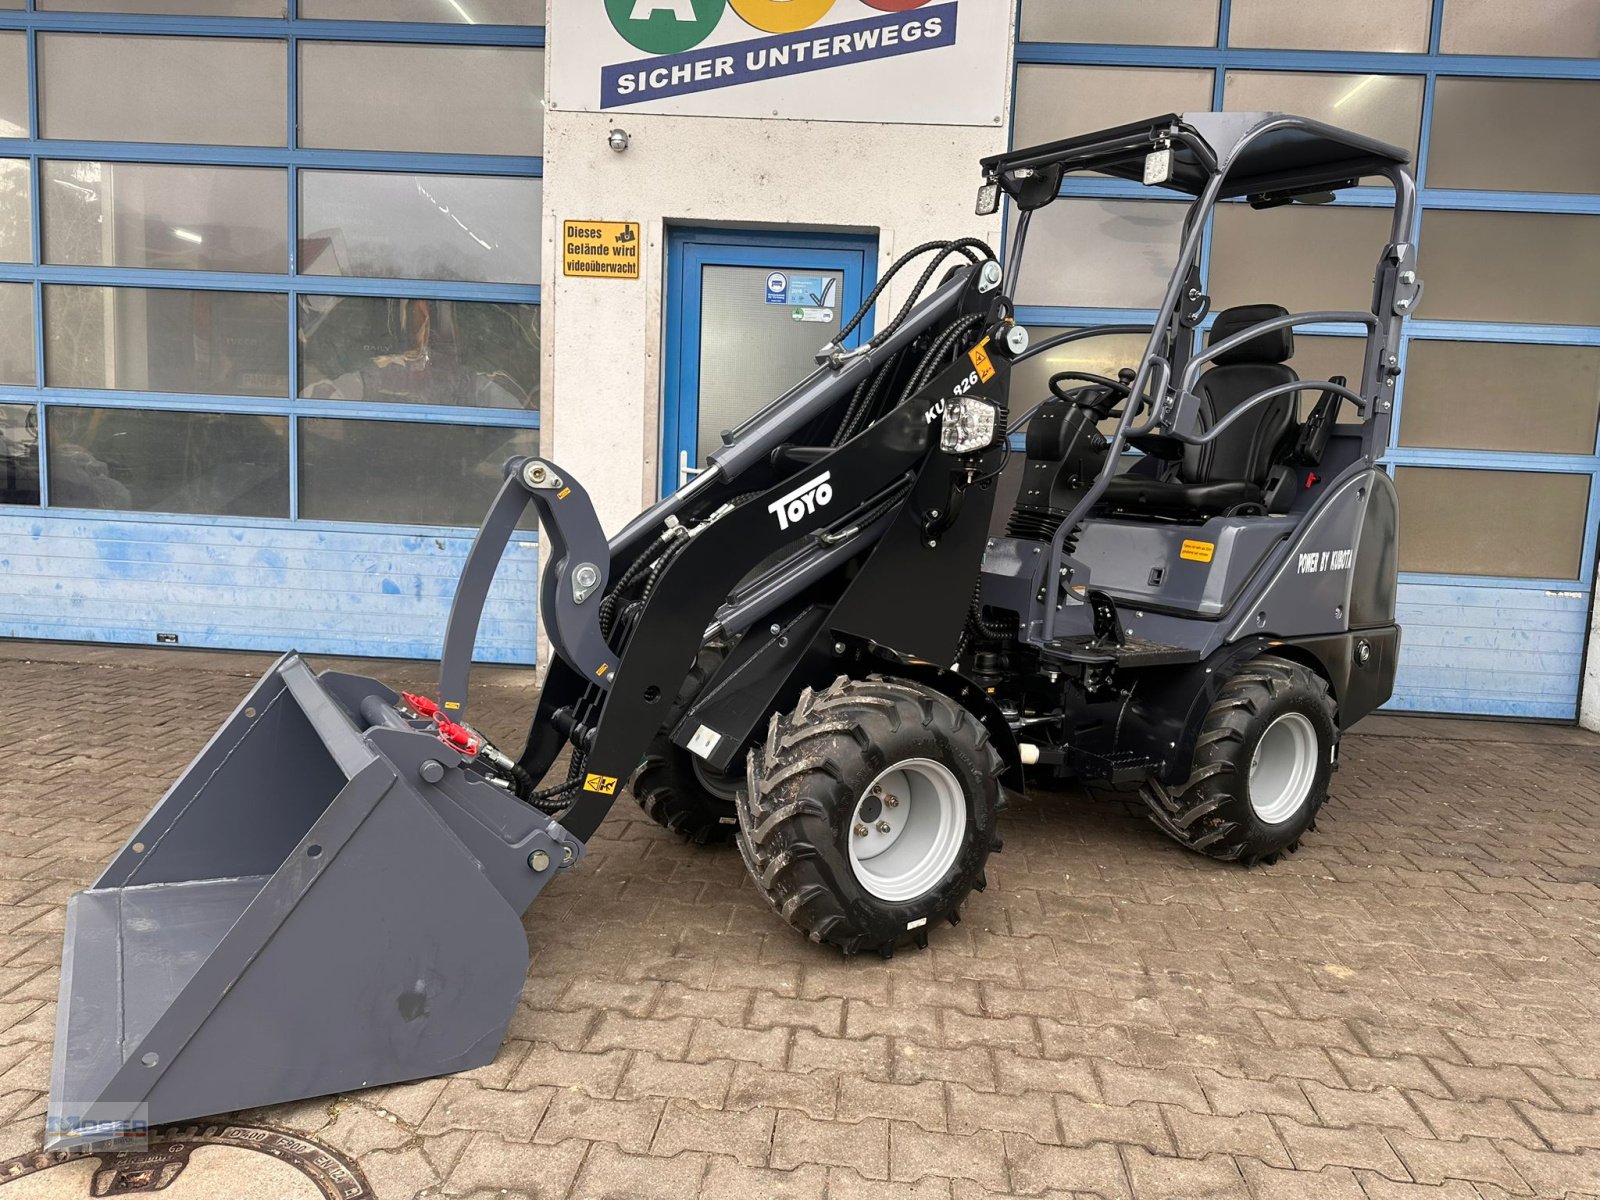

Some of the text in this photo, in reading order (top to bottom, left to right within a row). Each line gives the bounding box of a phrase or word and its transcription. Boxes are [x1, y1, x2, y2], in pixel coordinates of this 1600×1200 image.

[616, 16, 943, 96] SICHER UNTERWEGS
[567, 226, 602, 239] Dieses
[567, 243, 636, 257] Gelände wird
[567, 260, 636, 274] videoüberwacht
[767, 470, 833, 531] TOYO
[1297, 549, 1353, 574] POWER BY KUBOTA
[313, 1156, 333, 1169] EN
